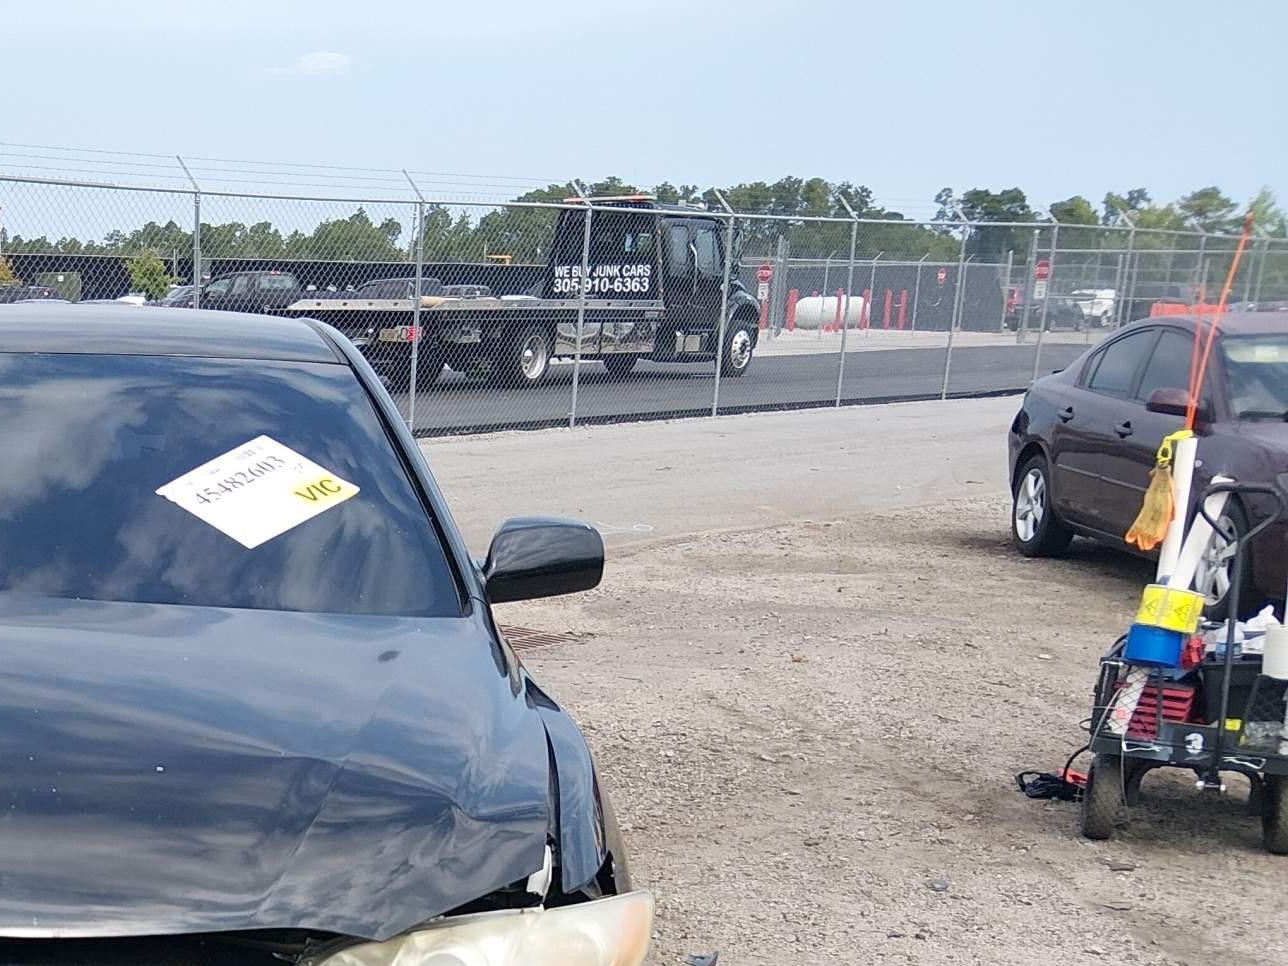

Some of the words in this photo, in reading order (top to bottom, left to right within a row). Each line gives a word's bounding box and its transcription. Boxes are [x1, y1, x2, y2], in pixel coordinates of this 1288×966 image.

[554, 265, 571, 278] WE
[592, 264, 621, 277] JUNK
[622, 264, 651, 277] CARS
[553, 277, 650, 292] 305-910-6363
[195, 455, 286, 505] 45482603
[294, 479, 342, 502] VIC
